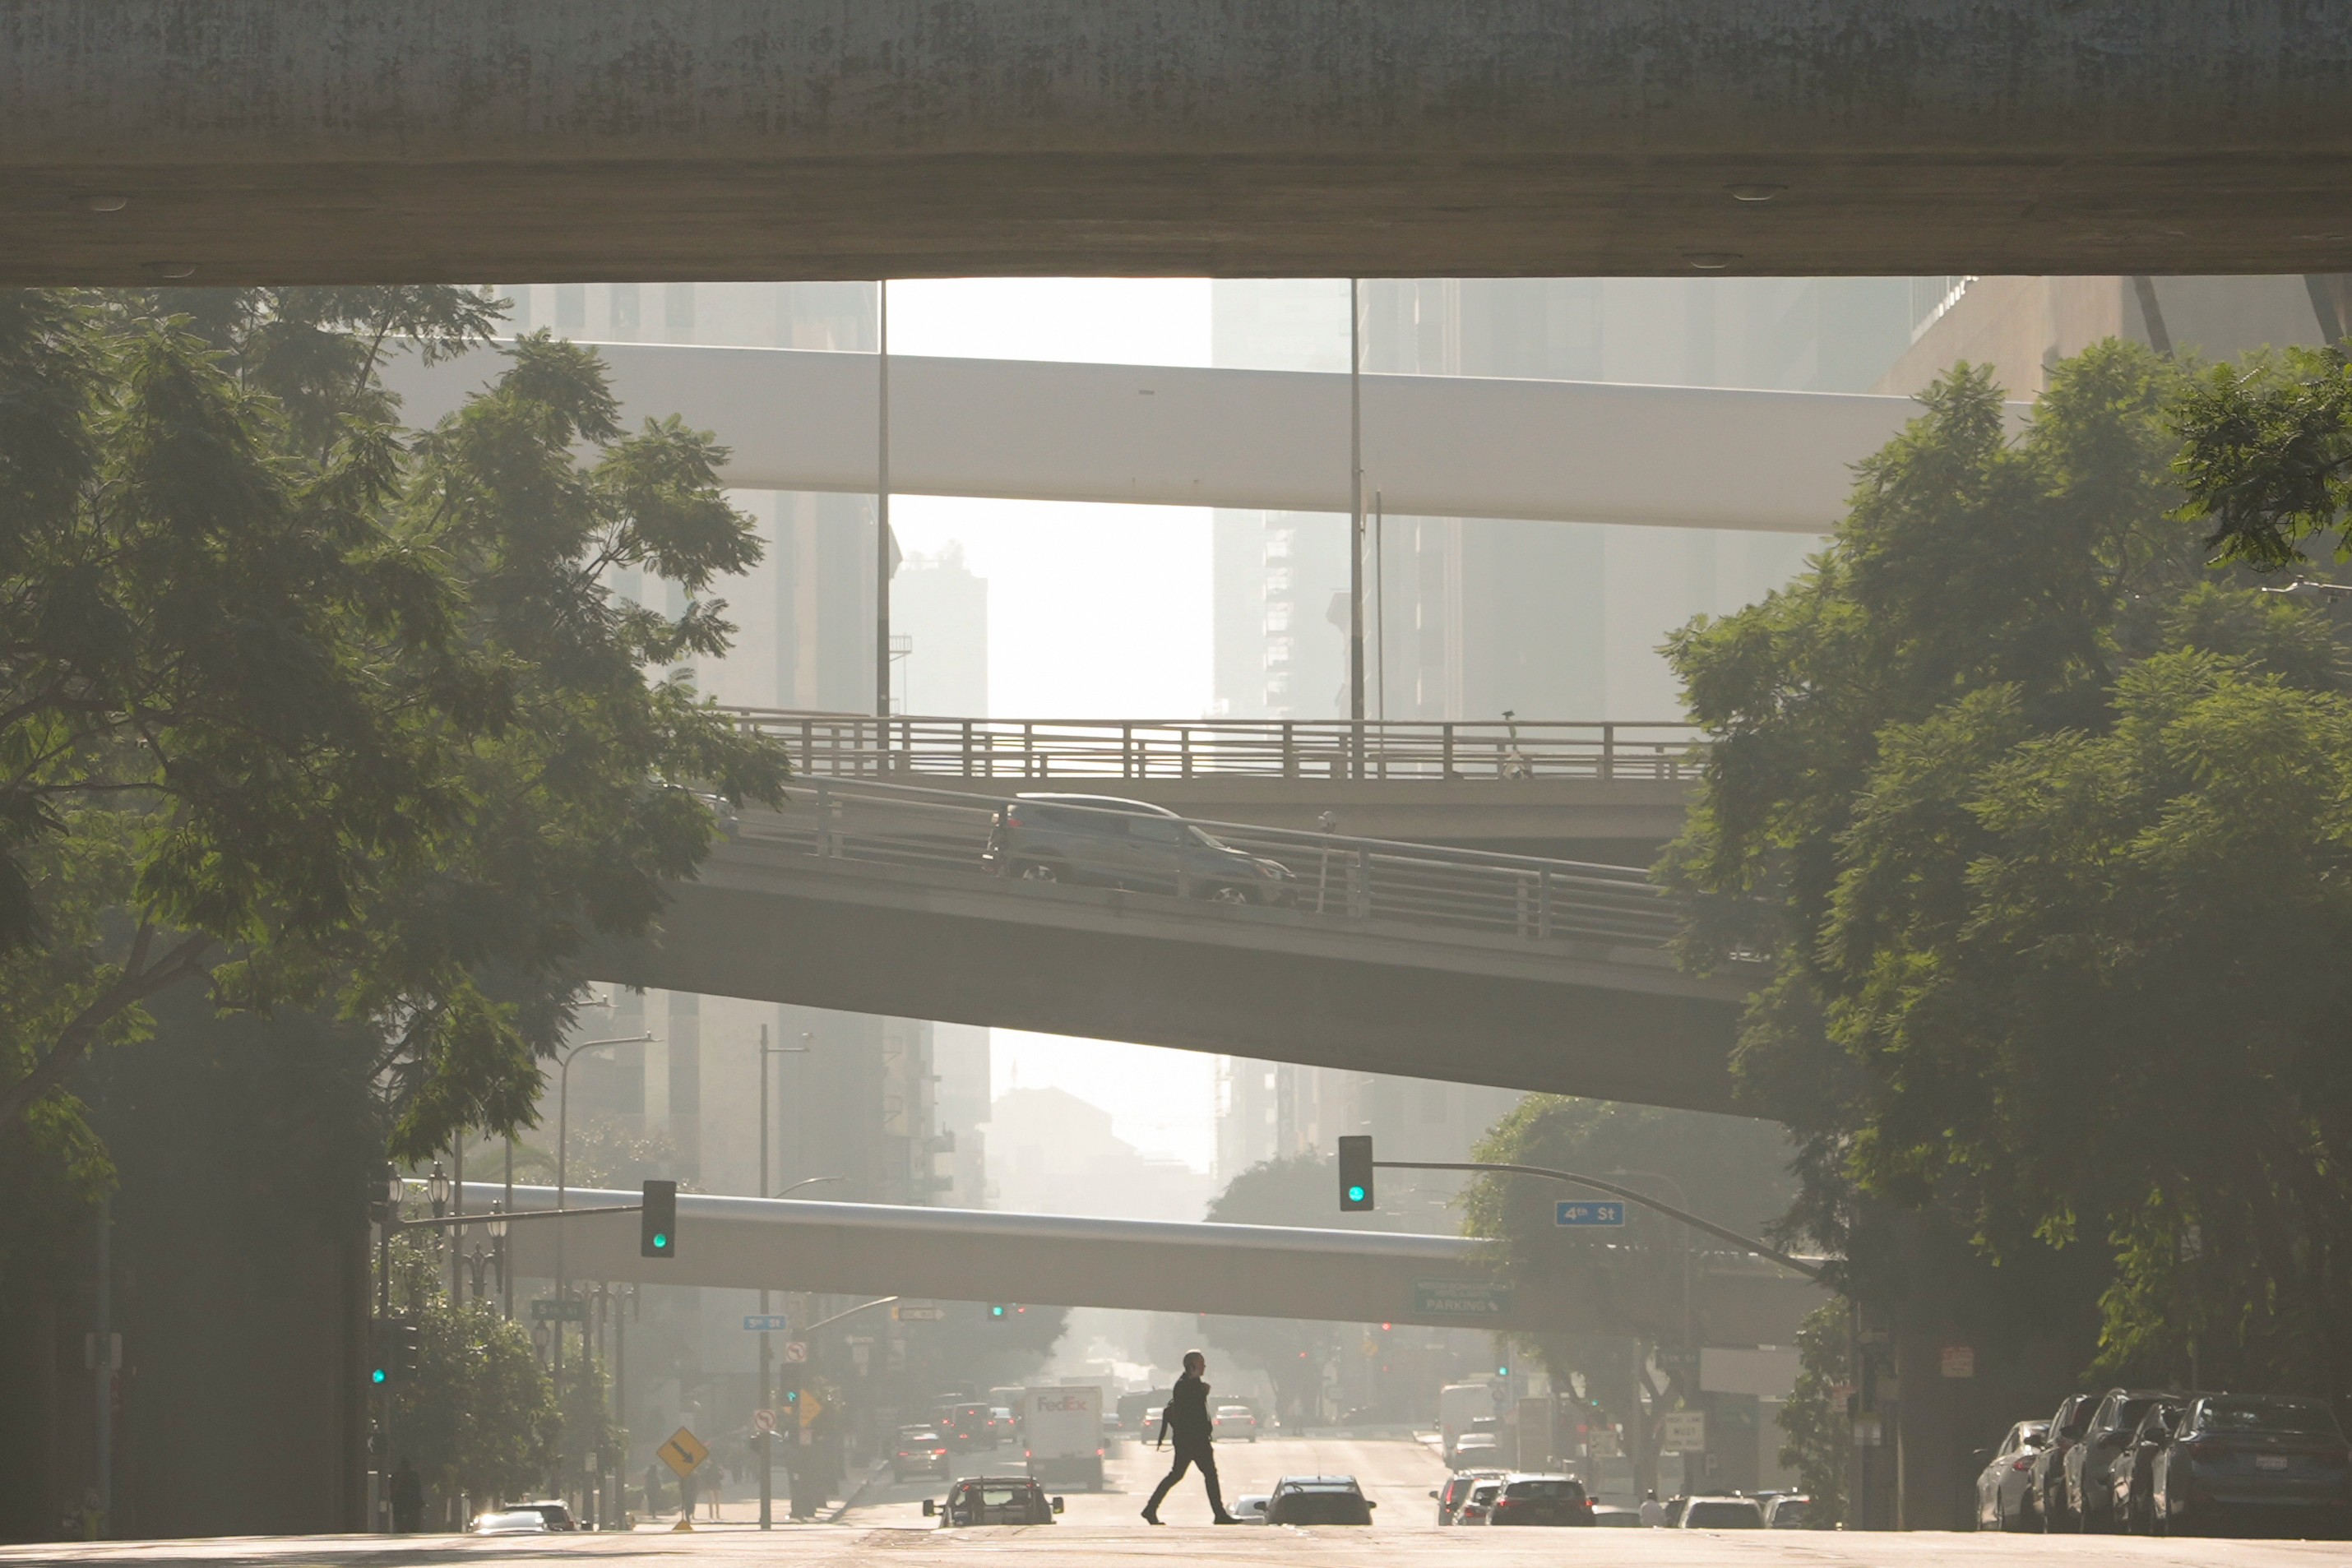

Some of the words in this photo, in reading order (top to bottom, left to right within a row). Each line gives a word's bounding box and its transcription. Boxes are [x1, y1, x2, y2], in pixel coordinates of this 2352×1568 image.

[1565, 1206, 1588, 1221] 4th
[1598, 1206, 1615, 1221] St
[1426, 1299, 1486, 1311] PARKING
[769, 1318, 780, 1328] St
[1037, 1396, 1088, 1412] FedEx
